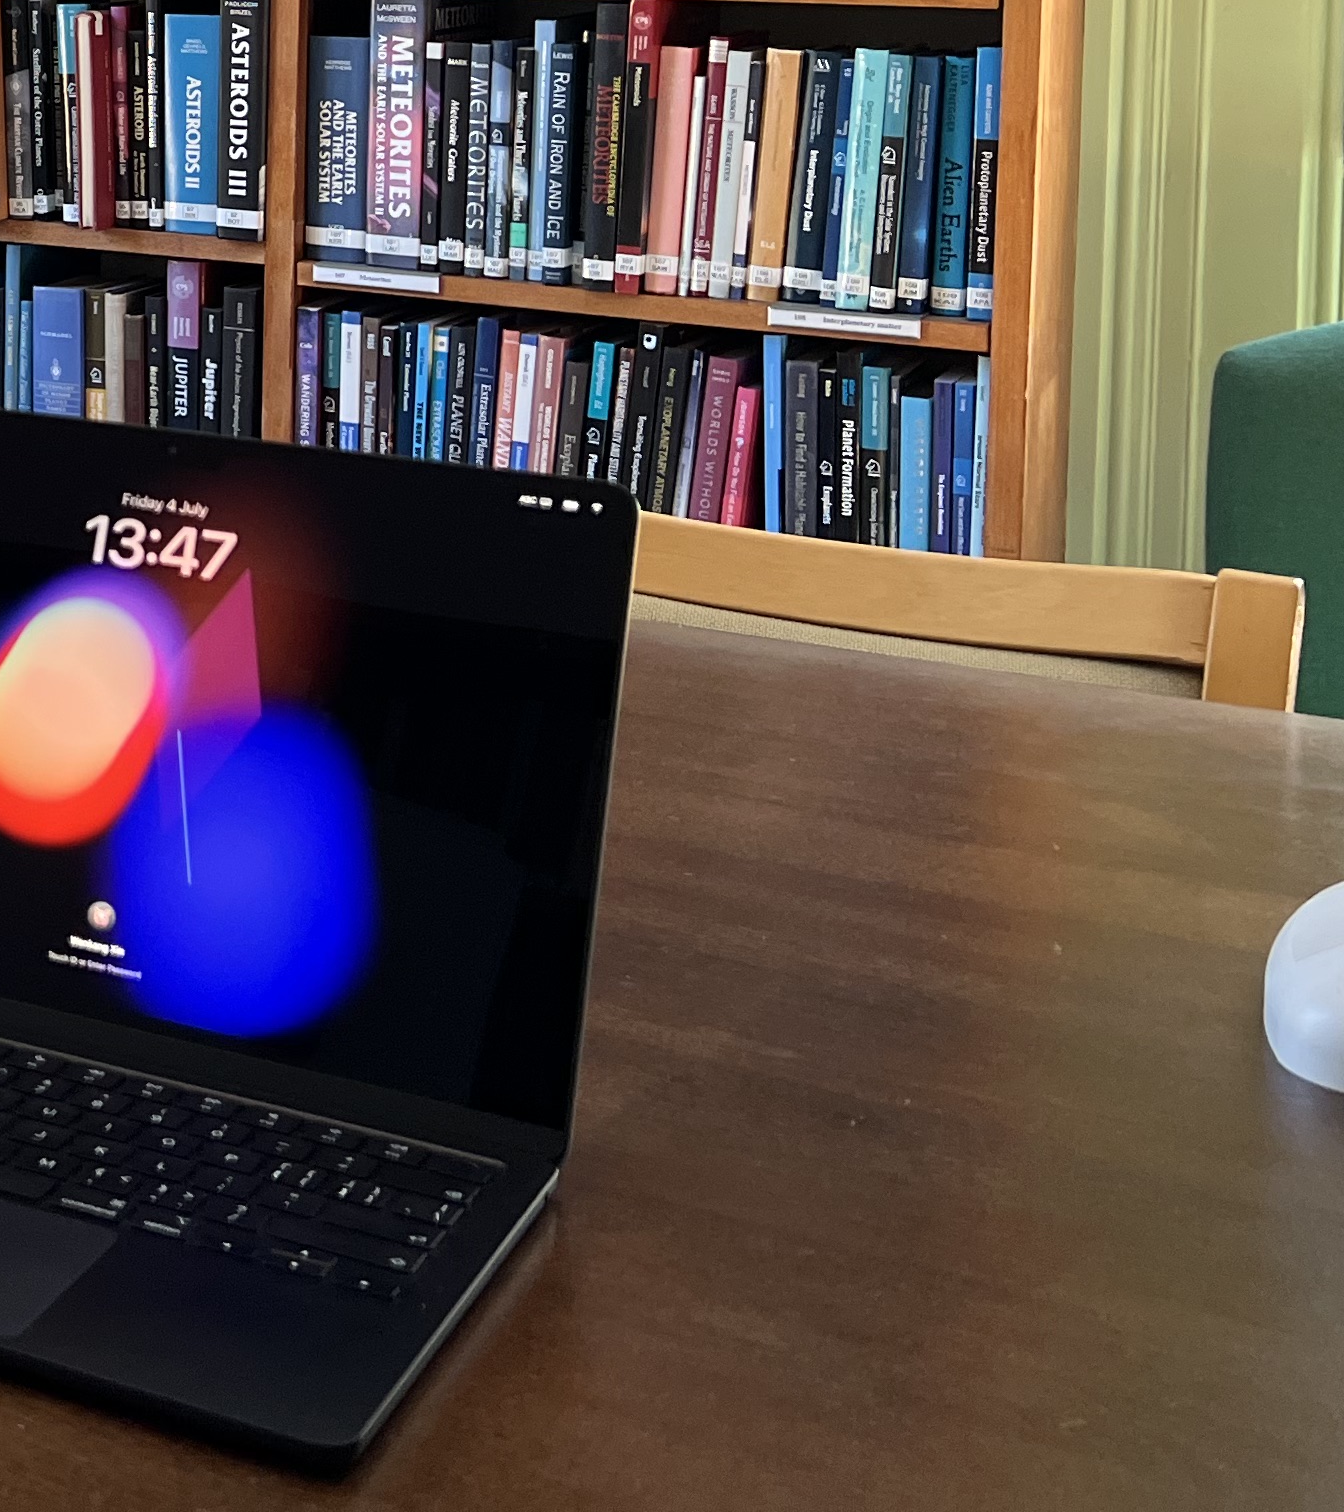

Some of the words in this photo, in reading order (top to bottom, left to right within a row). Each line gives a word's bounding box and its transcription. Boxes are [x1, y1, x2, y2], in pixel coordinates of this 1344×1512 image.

[378, 34, 388, 59] AND
[228, 22, 250, 160] ASTEROIDS
[377, 62, 387, 82] THE
[551, 71, 570, 109] RAIN
[320, 100, 332, 147] SOLAR
[332, 99, 344, 130] AND
[376, 86, 387, 119] EARLY
[184, 76, 202, 174] ASTEROIDS
[375, 122, 386, 159] SOLAR
[389, 35, 414, 218] METEORITES
[551, 114, 564, 134] OF
[592, 84, 611, 205] METEORITES
[332, 134, 344, 160] THE
[344, 110, 357, 195] METEORITES
[467, 77, 486, 229] METEORITES
[549, 138, 568, 175] IRON
[185, 177, 200, 188] II
[228, 169, 246, 196] III
[318, 150, 331, 203] SYSTEM
[331, 163, 344, 205] EARLY
[375, 162, 385, 204] SYSTEM
[548, 180, 561, 210] AND
[943, 157, 962, 206] Alien
[976, 151, 993, 235] Protoplanetary
[374, 207, 384, 216] II
[546, 216, 565, 240] ICE
[938, 213, 960, 272] Earths
[976, 237, 990, 263] Dust
[172, 355, 189, 417] JUPITER
[202, 358, 218, 420] Jupiter
[299, 374, 311, 437] WANDERING
[841, 420, 855, 457] Planet
[122, 492, 164, 514] Friday
[166, 498, 177, 511] 4
[179, 500, 210, 521] July
[841, 459, 854, 516] Formation
[85, 514, 238, 582] 13:47
